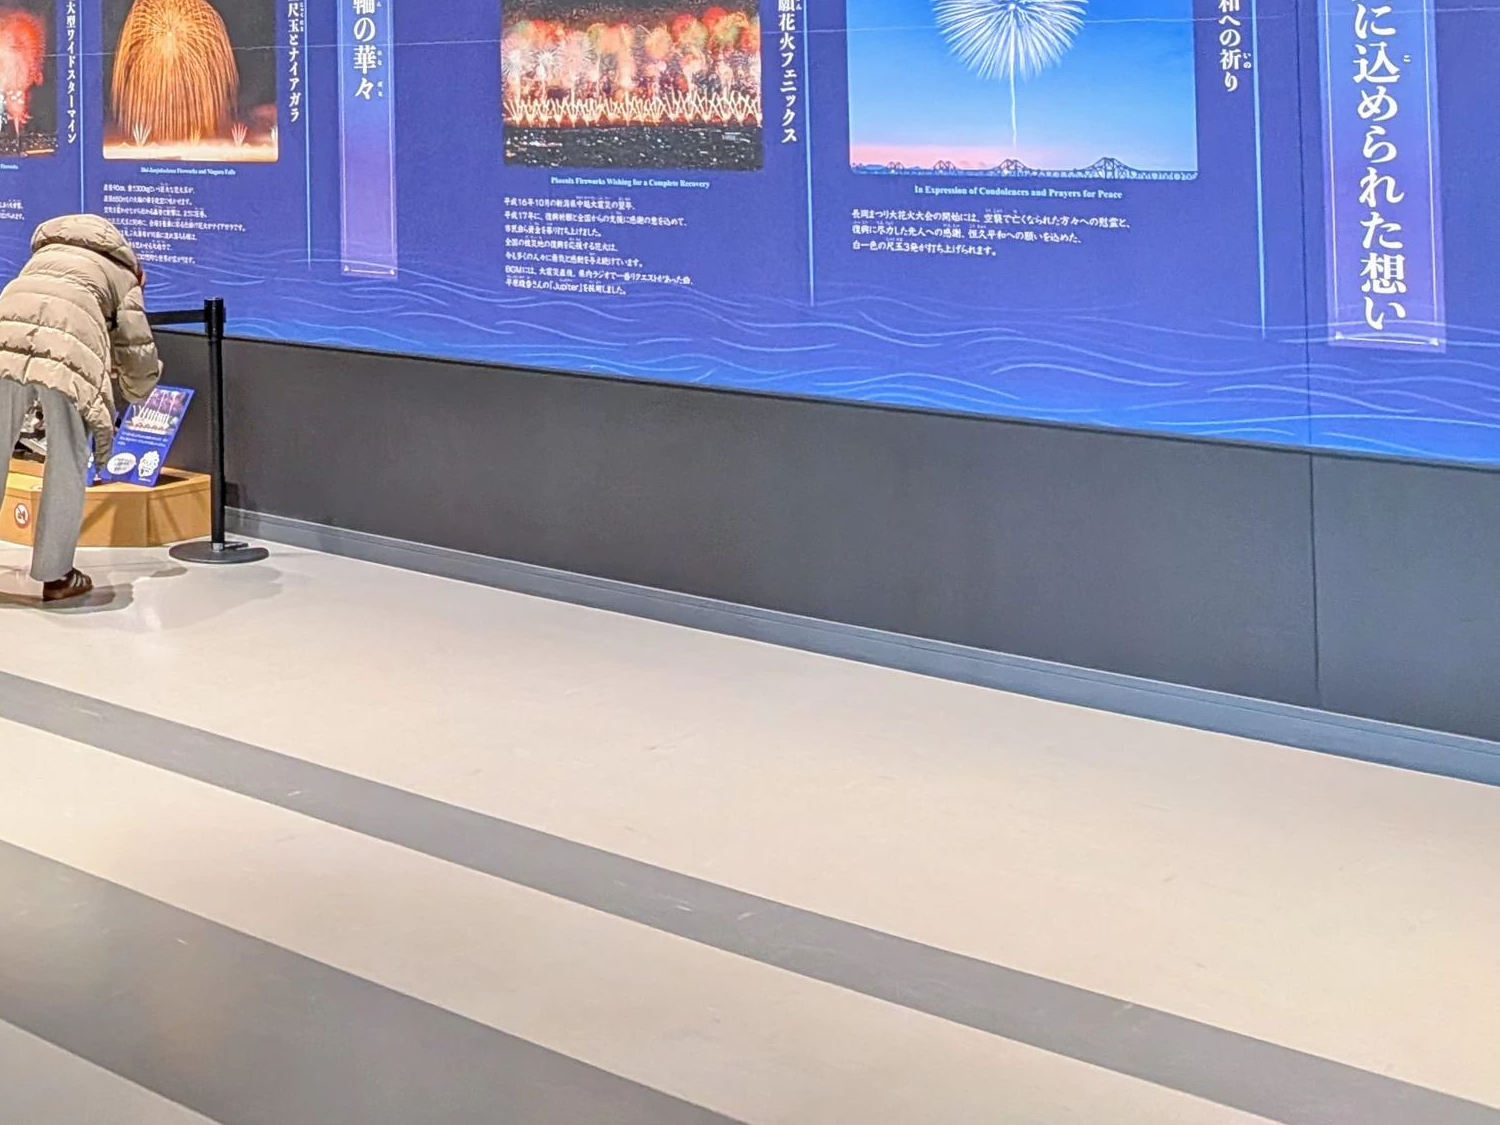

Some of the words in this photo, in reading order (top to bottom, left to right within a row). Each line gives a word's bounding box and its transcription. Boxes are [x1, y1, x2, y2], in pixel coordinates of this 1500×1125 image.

[914, 185, 923, 194] In
[925, 185, 967, 196] Expression
[969, 186, 977, 195] of
[979, 187, 1029, 196] Condolences
[1031, 188, 1047, 197] and
[1049, 189, 1081, 199] Prayers
[1083, 189, 1096, 198] for
[1098, 190, 1122, 199] Peace
